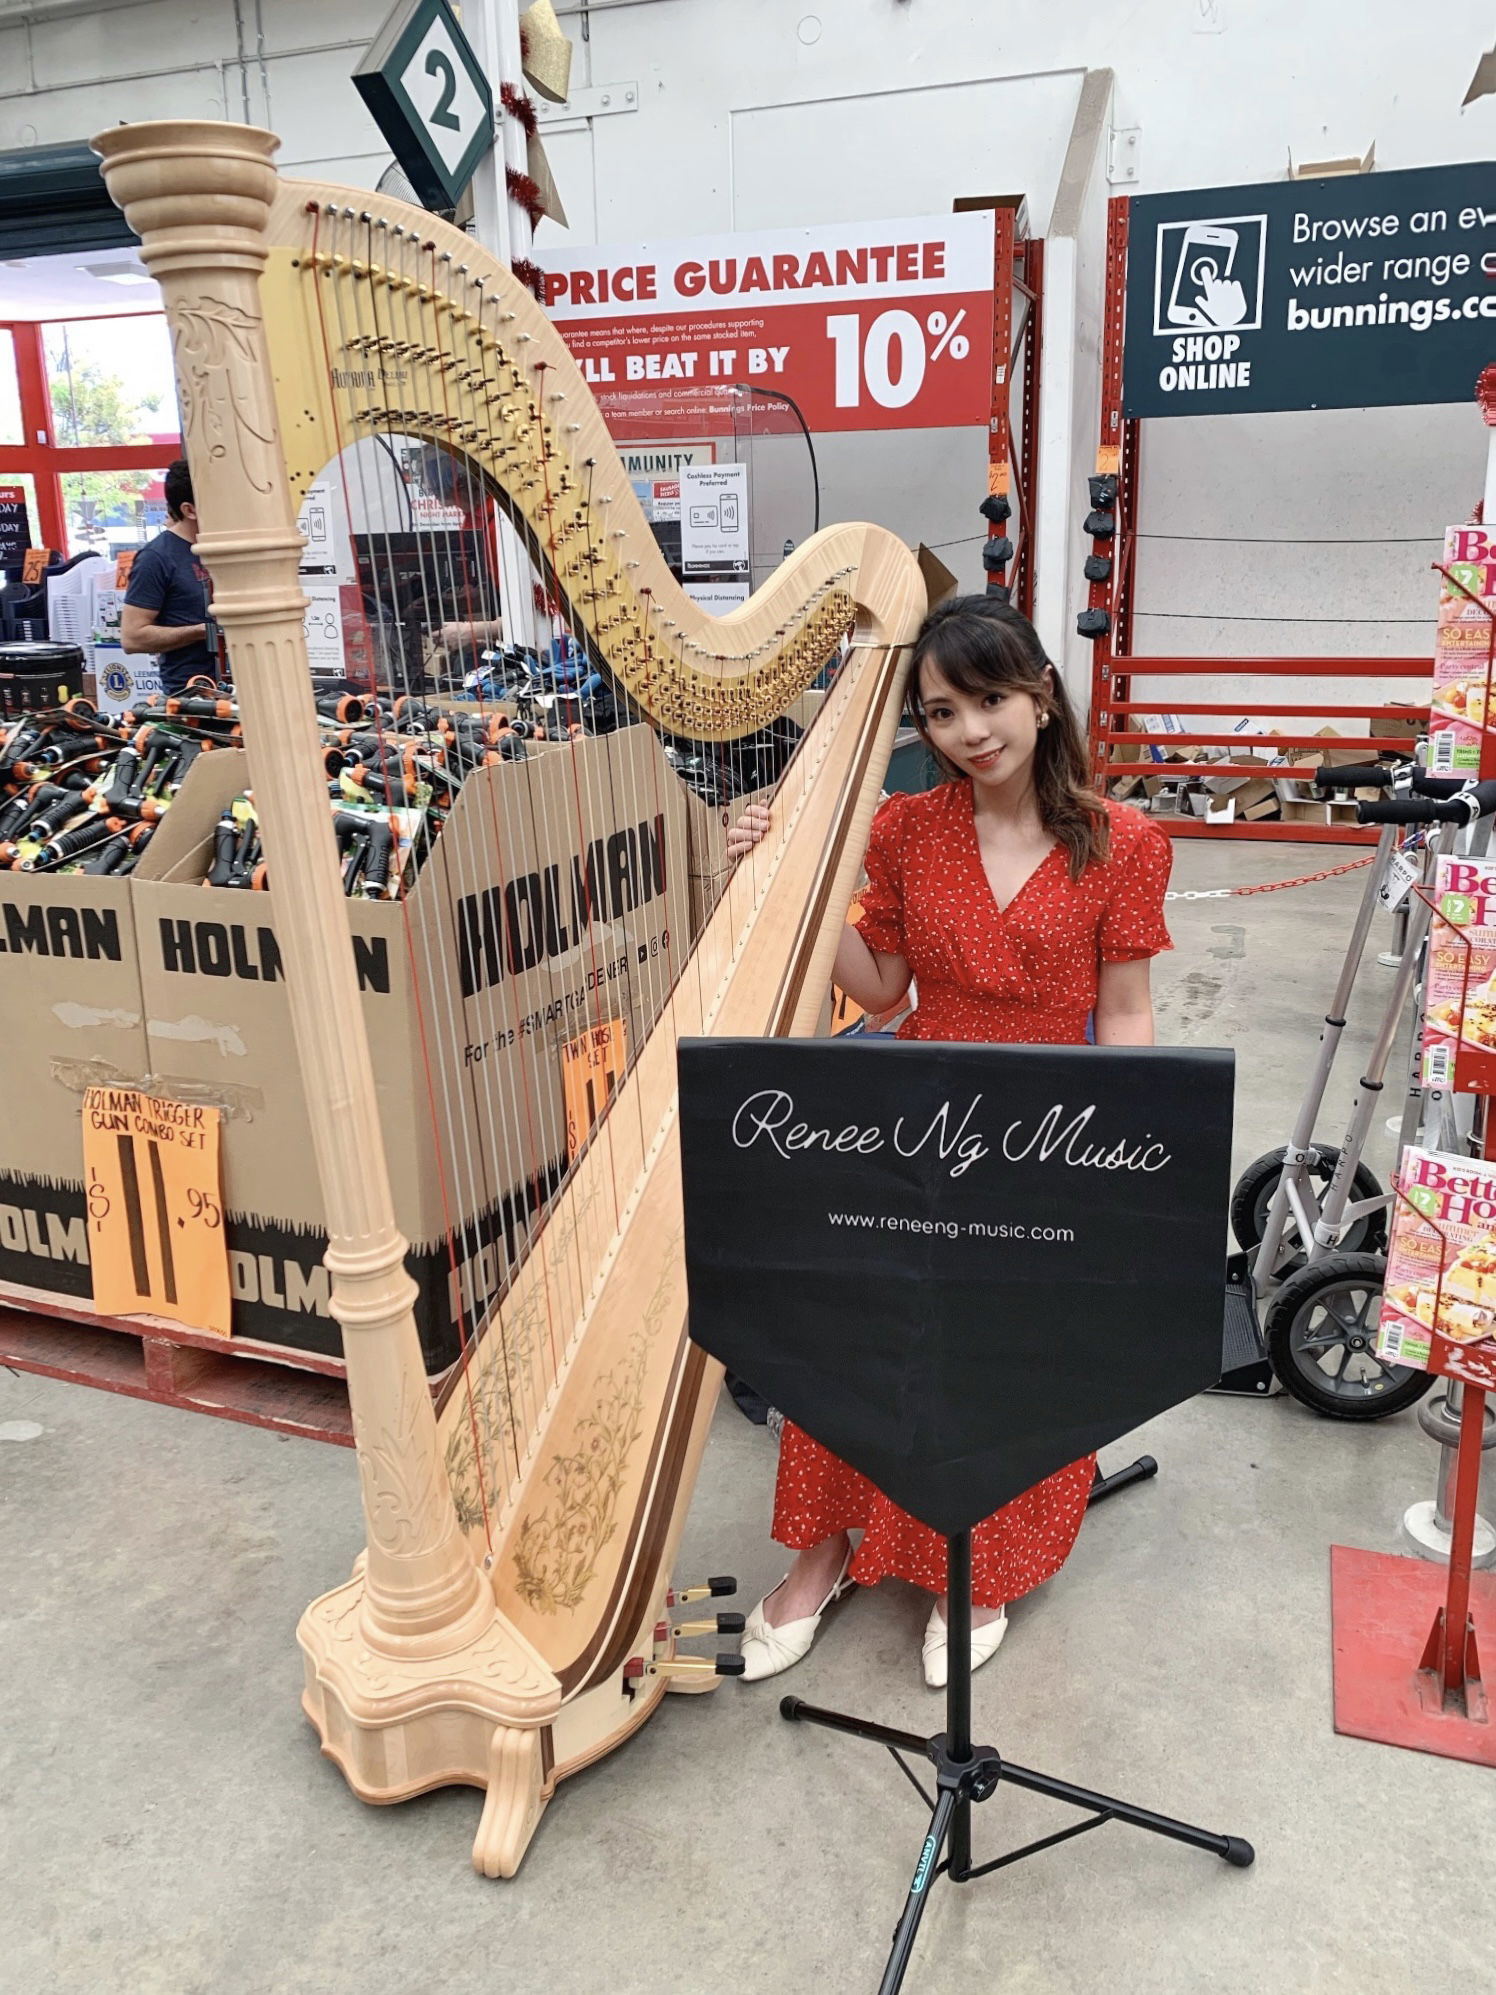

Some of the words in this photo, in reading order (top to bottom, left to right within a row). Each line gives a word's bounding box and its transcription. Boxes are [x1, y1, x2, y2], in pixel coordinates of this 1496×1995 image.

[423, 48, 462, 133] 2
[1293, 212, 1400, 243] Browse
[1410, 210, 1447, 233] an
[1459, 206, 1496, 229] ev
[544, 265, 657, 307] PRICE
[674, 241, 946, 297] GUARANTEE
[1289, 251, 1373, 287] wider
[1383, 253, 1471, 286] range
[1481, 251, 1496, 273] o
[561, 330, 588, 339] uarantee
[590, 329, 611, 337] means
[612, 327, 625, 336] that
[626, 325, 649, 335] where,
[650, 324, 675, 334] despite
[689, 320, 727, 332] procedures
[728, 317, 765, 329] supporting
[572, 339, 585, 348] find
[592, 337, 631, 349] competitor's
[632, 335, 651, 345] lower
[652, 334, 669, 346] price
[681, 333, 692, 342] the
[694, 333, 711, 341] same
[713, 329, 739, 339] stocked
[576, 357, 616, 383] 'LL
[626, 352, 698, 381] BEAT
[709, 350, 737, 376] IT
[748, 346, 790, 374] BY
[826, 308, 970, 409] 10%
[1172, 334, 1241, 364] SHOP
[1158, 361, 1251, 392] ONLINE
[611, 410, 627, 418] team
[628, 408, 654, 417] member
[663, 406, 685, 416] search
[708, 404, 745, 414] Bunnings
[746, 403, 766, 411] Price
[767, 402, 790, 412] Policy
[618, 390, 657, 401] liquidations
[658, 390, 672, 398] and
[620, 453, 694, 473] MUNITY
[686, 472, 713, 480] Cashless
[713, 471, 741, 480] Payment
[0, 491, 15, 499] urs
[699, 479, 728, 487] Preferred
[0, 503, 19, 513] DAY
[1442, 627, 1462, 640] SO
[1464, 627, 1490, 640] EAS
[135, 680, 161, 690] LION
[457, 813, 667, 999] HOLMAN
[0, 903, 122, 961] MAN
[159, 918, 391, 994] HOLN
[1436, 951, 1454, 963] SO
[464, 1042, 489, 1067] For
[517, 955, 629, 1041] #SMARTGADENER
[84, 1088, 142, 1114] HOLMAN
[91, 1110, 129, 1131] GUN
[179, 1131, 206, 1150] SET
[731, 1089, 885, 1160] Renee
[893, 1093, 990, 1178] Ng
[1002, 1104, 1173, 1175] Music
[1413, 1157, 1496, 1201] Bett
[0, 1202, 91, 1267] OLM
[828, 1210, 1076, 1243] www.reneeng-music.com
[1399, 1236, 1418, 1250] SO
[226, 1248, 331, 1319] OLM
